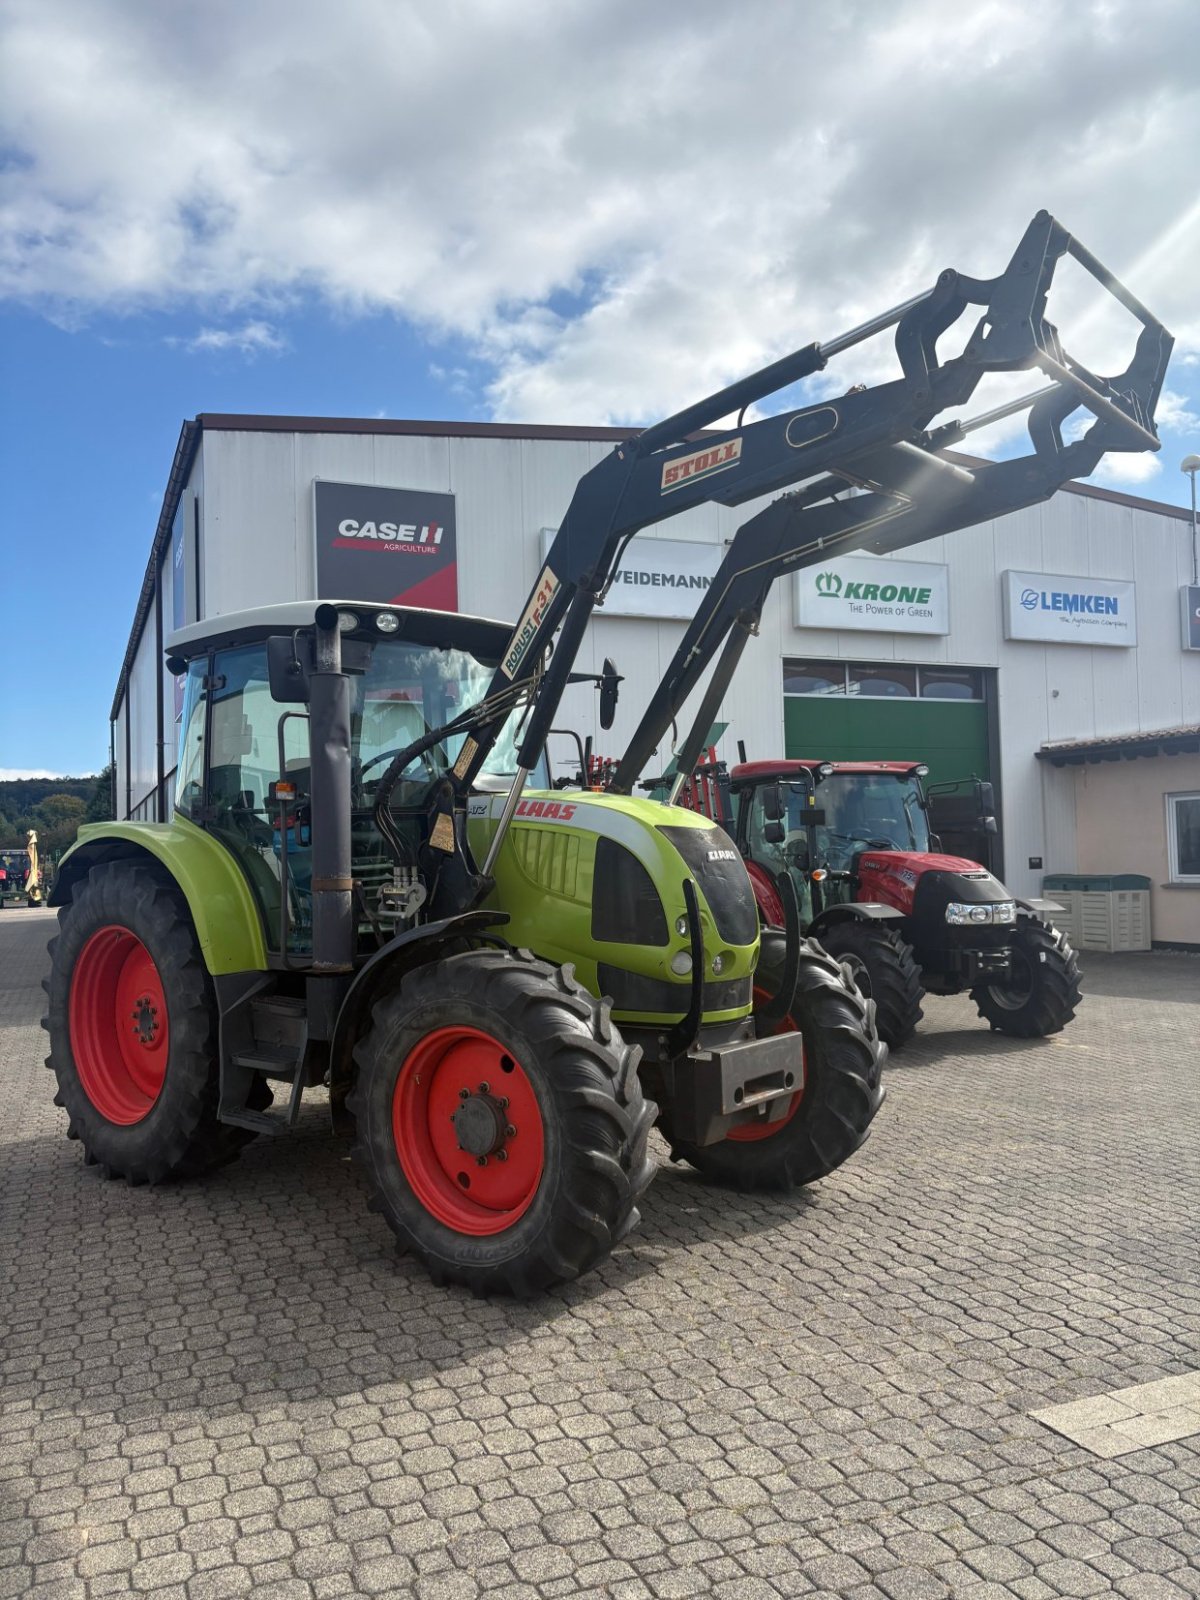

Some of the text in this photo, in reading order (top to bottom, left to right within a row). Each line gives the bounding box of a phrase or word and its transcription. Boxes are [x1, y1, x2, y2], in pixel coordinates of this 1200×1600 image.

[664, 442, 738, 485] STOLL
[338, 519, 417, 542] CASE
[383, 543, 437, 554] AGRICULTURE
[843, 582, 932, 604] KRONE
[1041, 591, 1118, 616] LEMKEN
[866, 603, 893, 615] POWER
[907, 606, 933, 618] GREEN
[505, 579, 553, 673] ROBUST F31
[515, 801, 578, 820] LAAS
